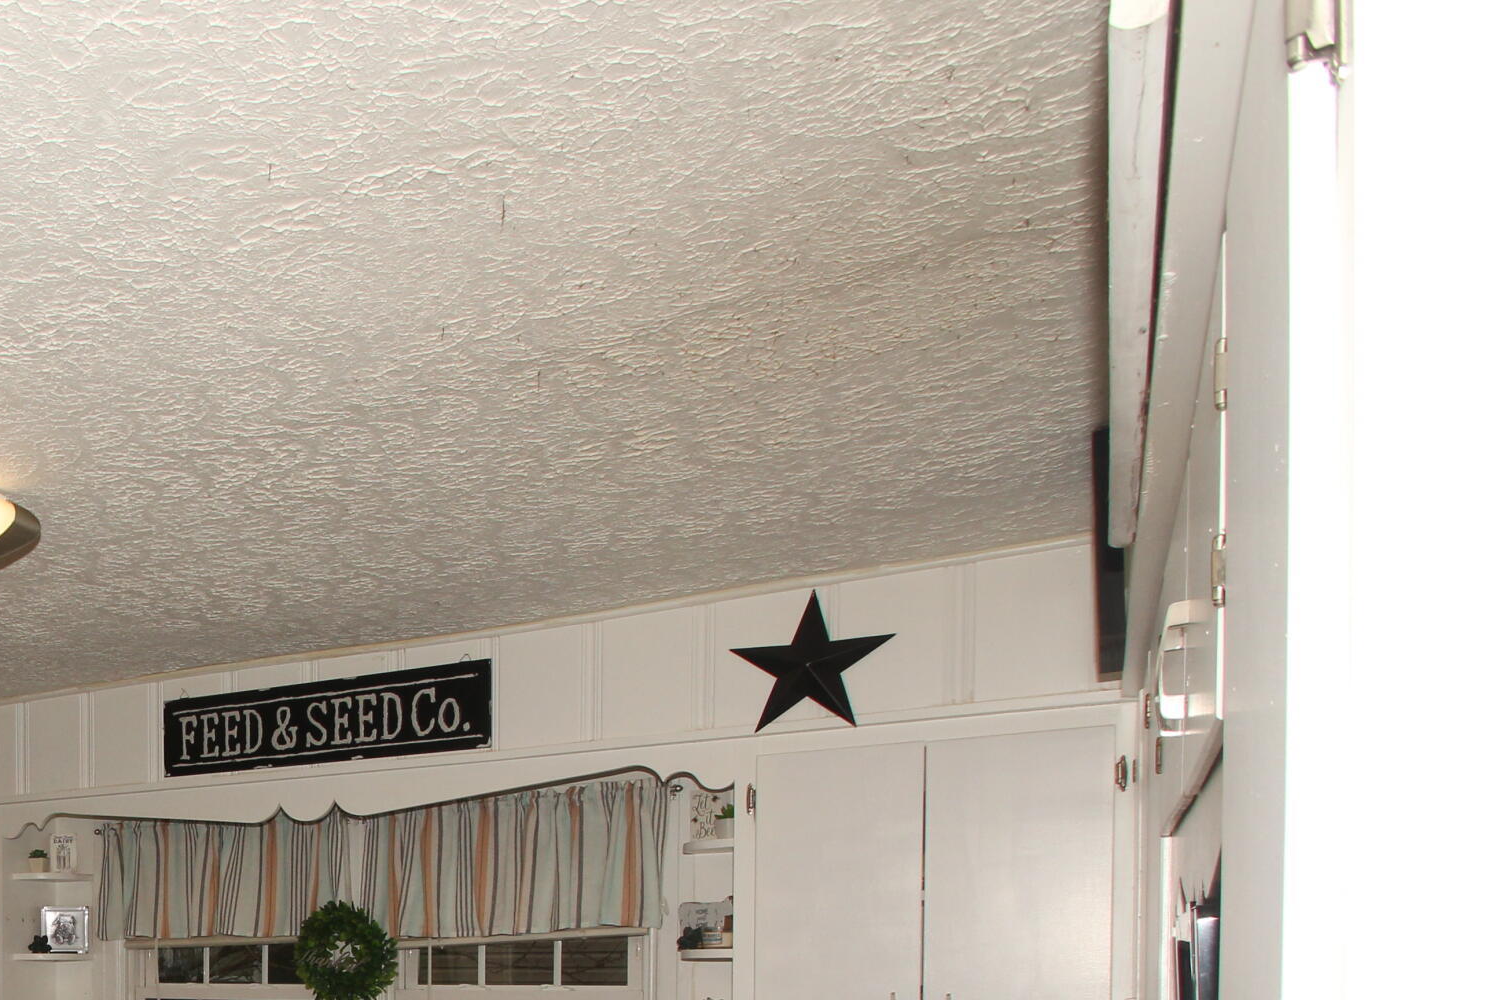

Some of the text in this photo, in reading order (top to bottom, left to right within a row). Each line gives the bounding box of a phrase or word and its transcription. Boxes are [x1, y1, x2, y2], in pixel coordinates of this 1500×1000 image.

[179, 687, 471, 760] FEED & SEED Co.
[692, 794, 710, 817] Let
